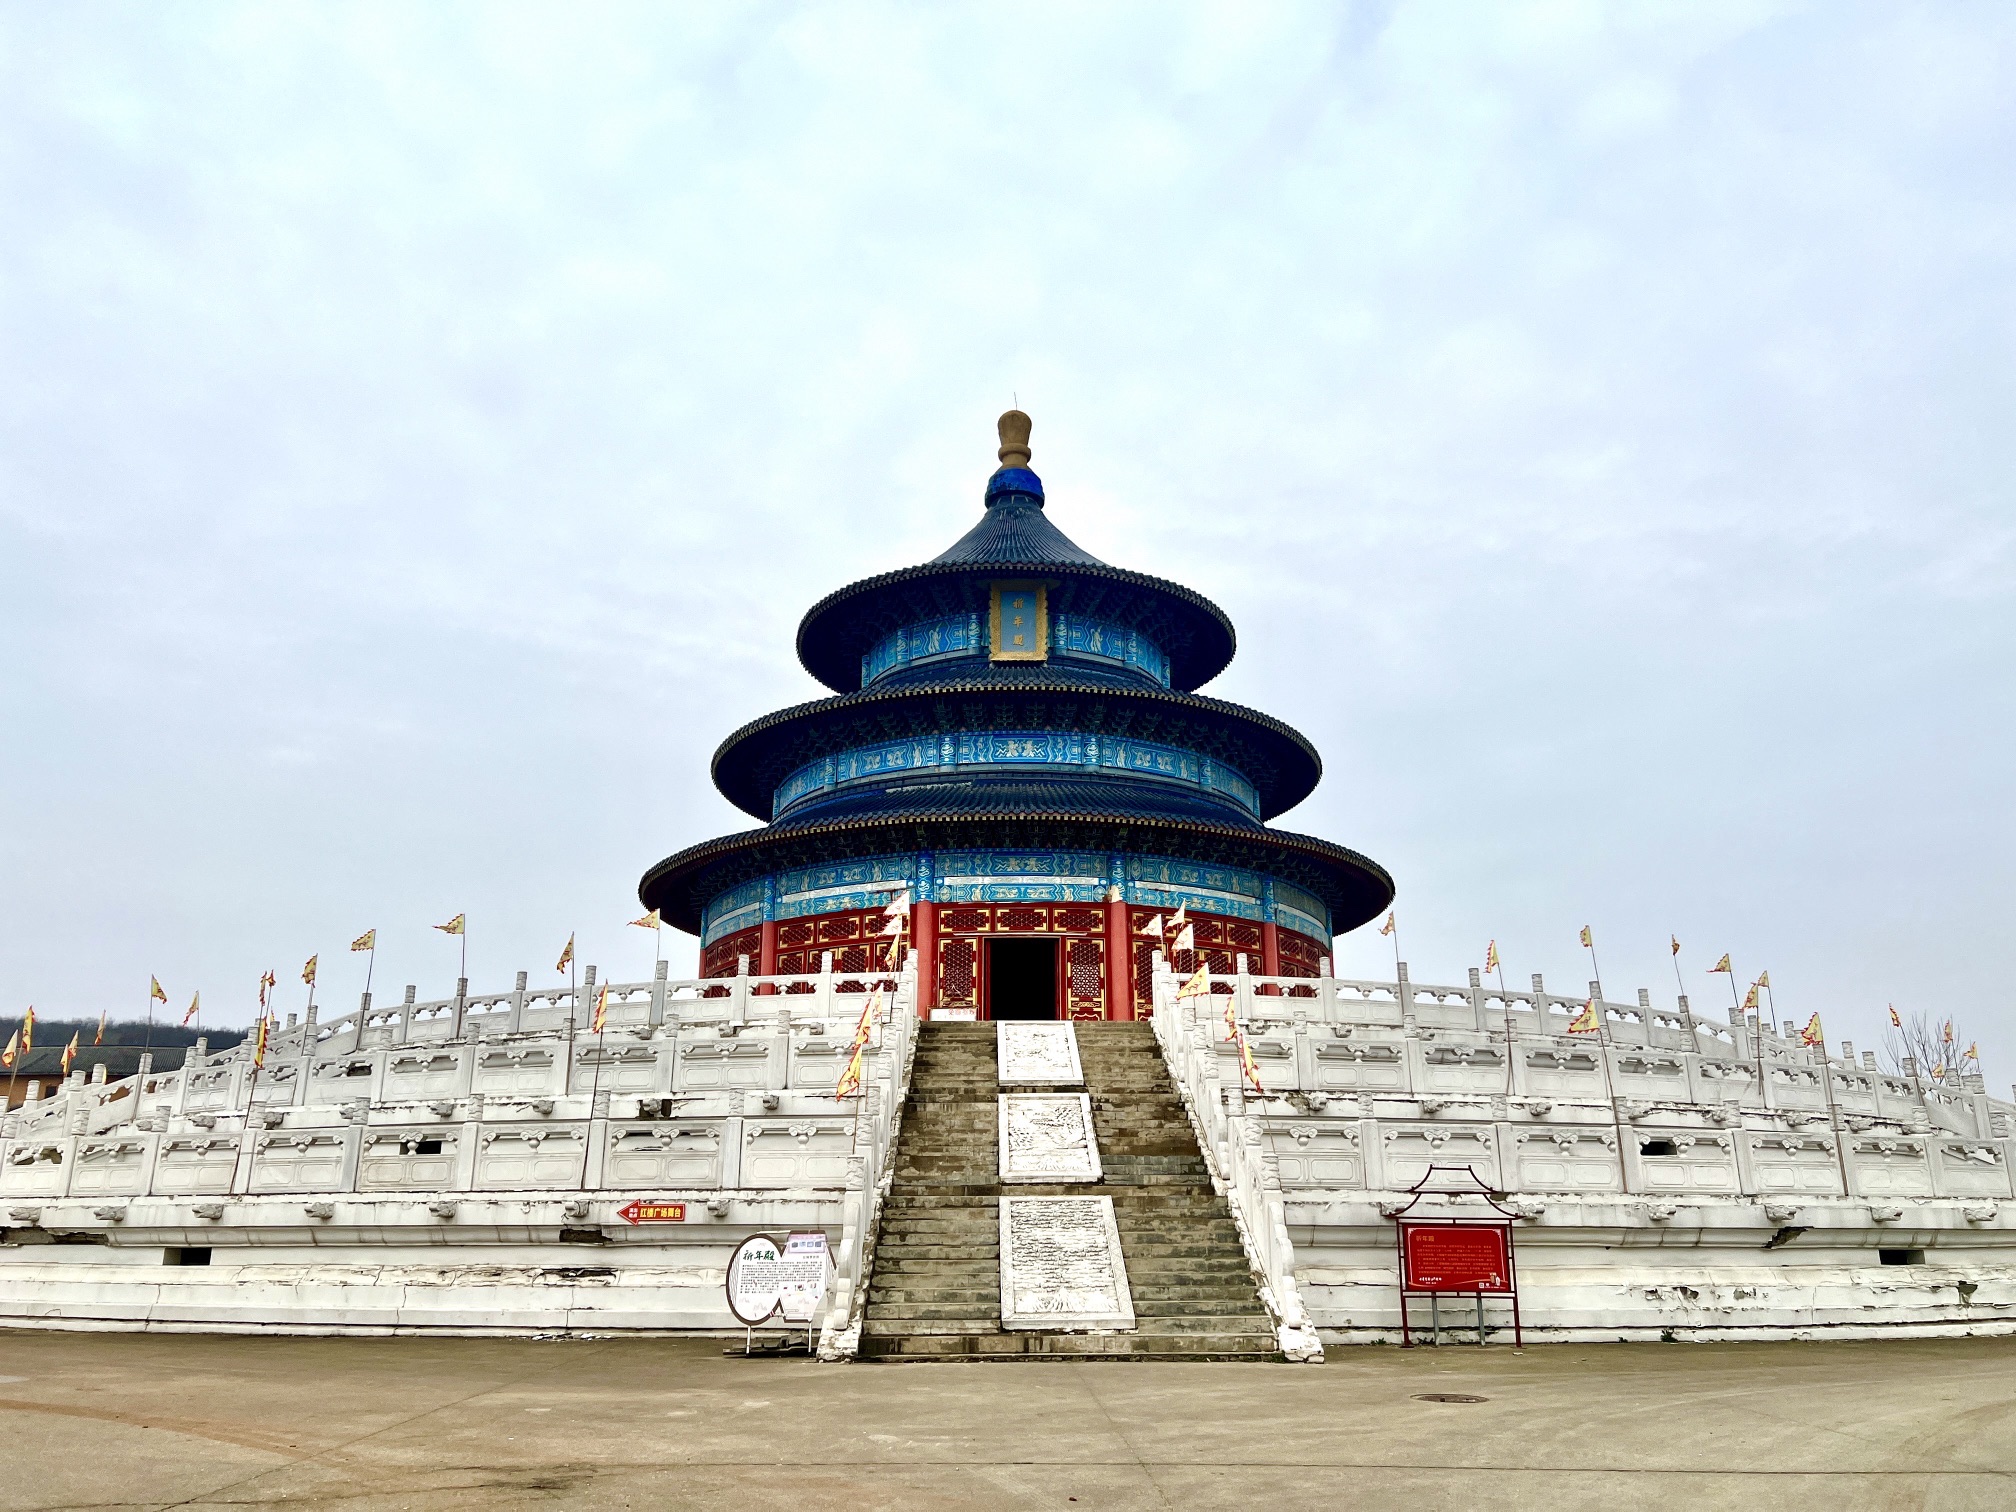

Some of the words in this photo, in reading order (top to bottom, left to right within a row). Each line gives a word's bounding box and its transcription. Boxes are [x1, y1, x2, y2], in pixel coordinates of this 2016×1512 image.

[640, 1208, 681, 1217] 红楼广场舞台
[743, 1250, 775, 1261] 祈年殿
